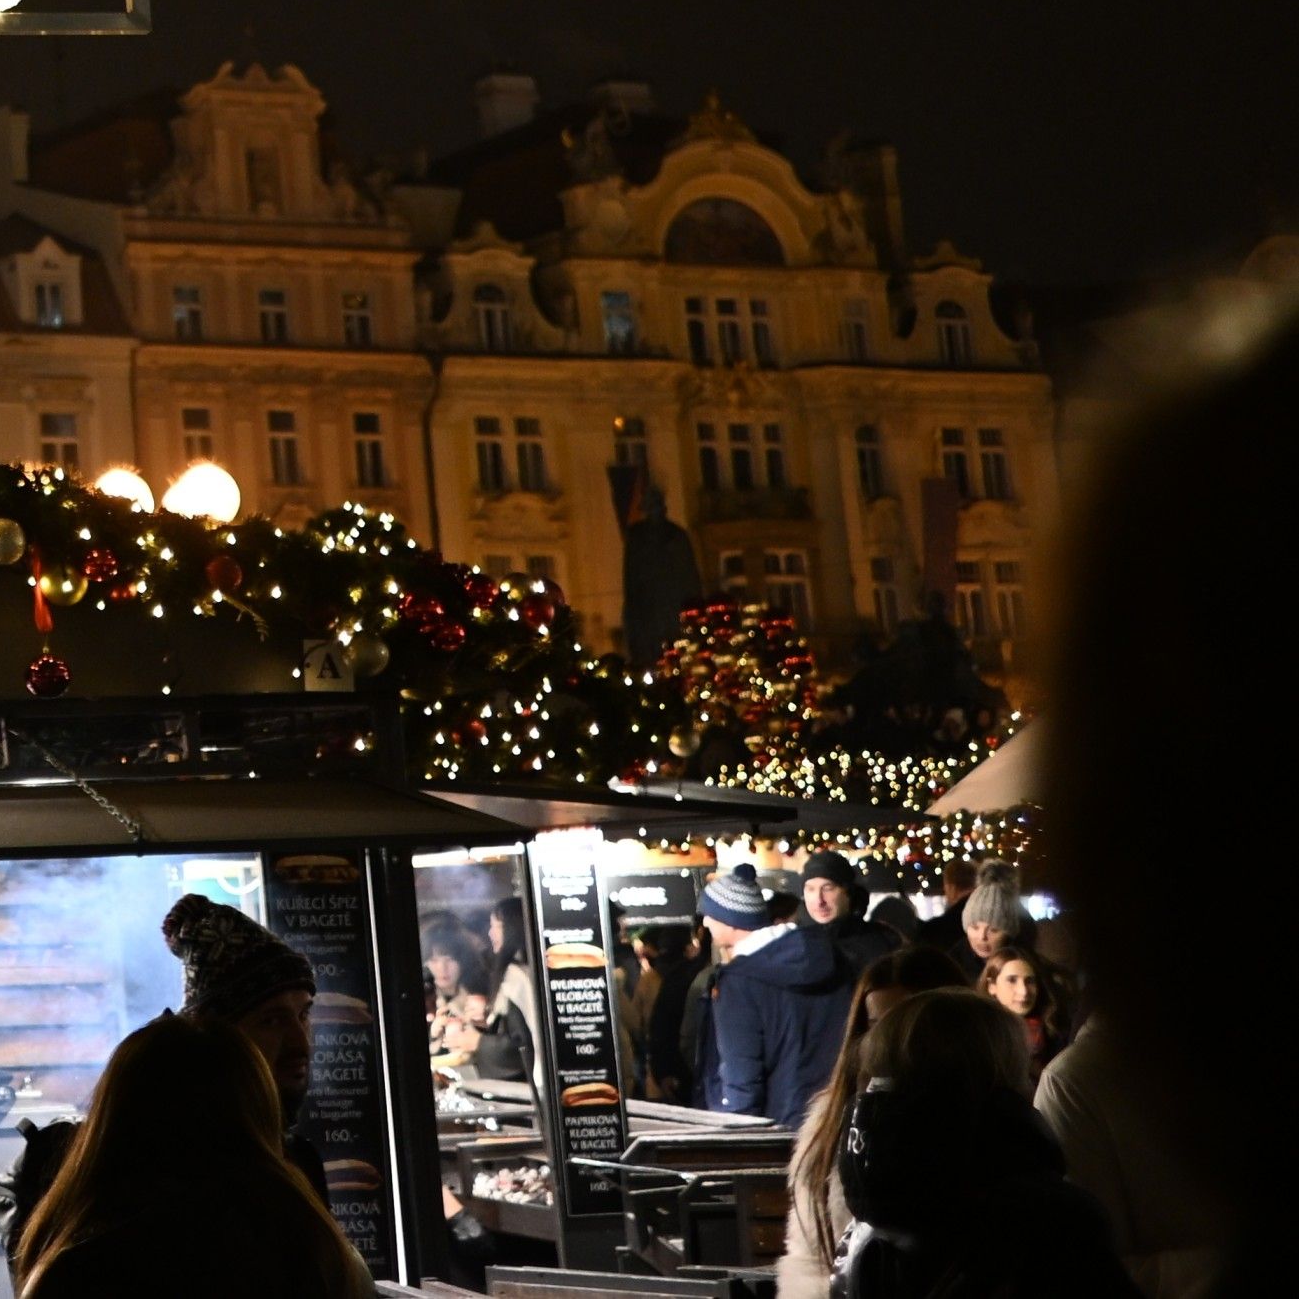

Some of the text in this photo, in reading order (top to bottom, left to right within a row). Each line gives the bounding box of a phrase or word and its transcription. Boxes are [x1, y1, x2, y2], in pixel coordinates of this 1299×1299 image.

[284, 911, 352, 927] V BAGETĚ
[556, 1004, 565, 1014] V
[311, 1031, 371, 1046] INKOVÁ
[311, 1048, 367, 1063] OBÁSA
[330, 1199, 381, 1216] RIKOVÁ
[351, 1235, 378, 1251] ETĚ
